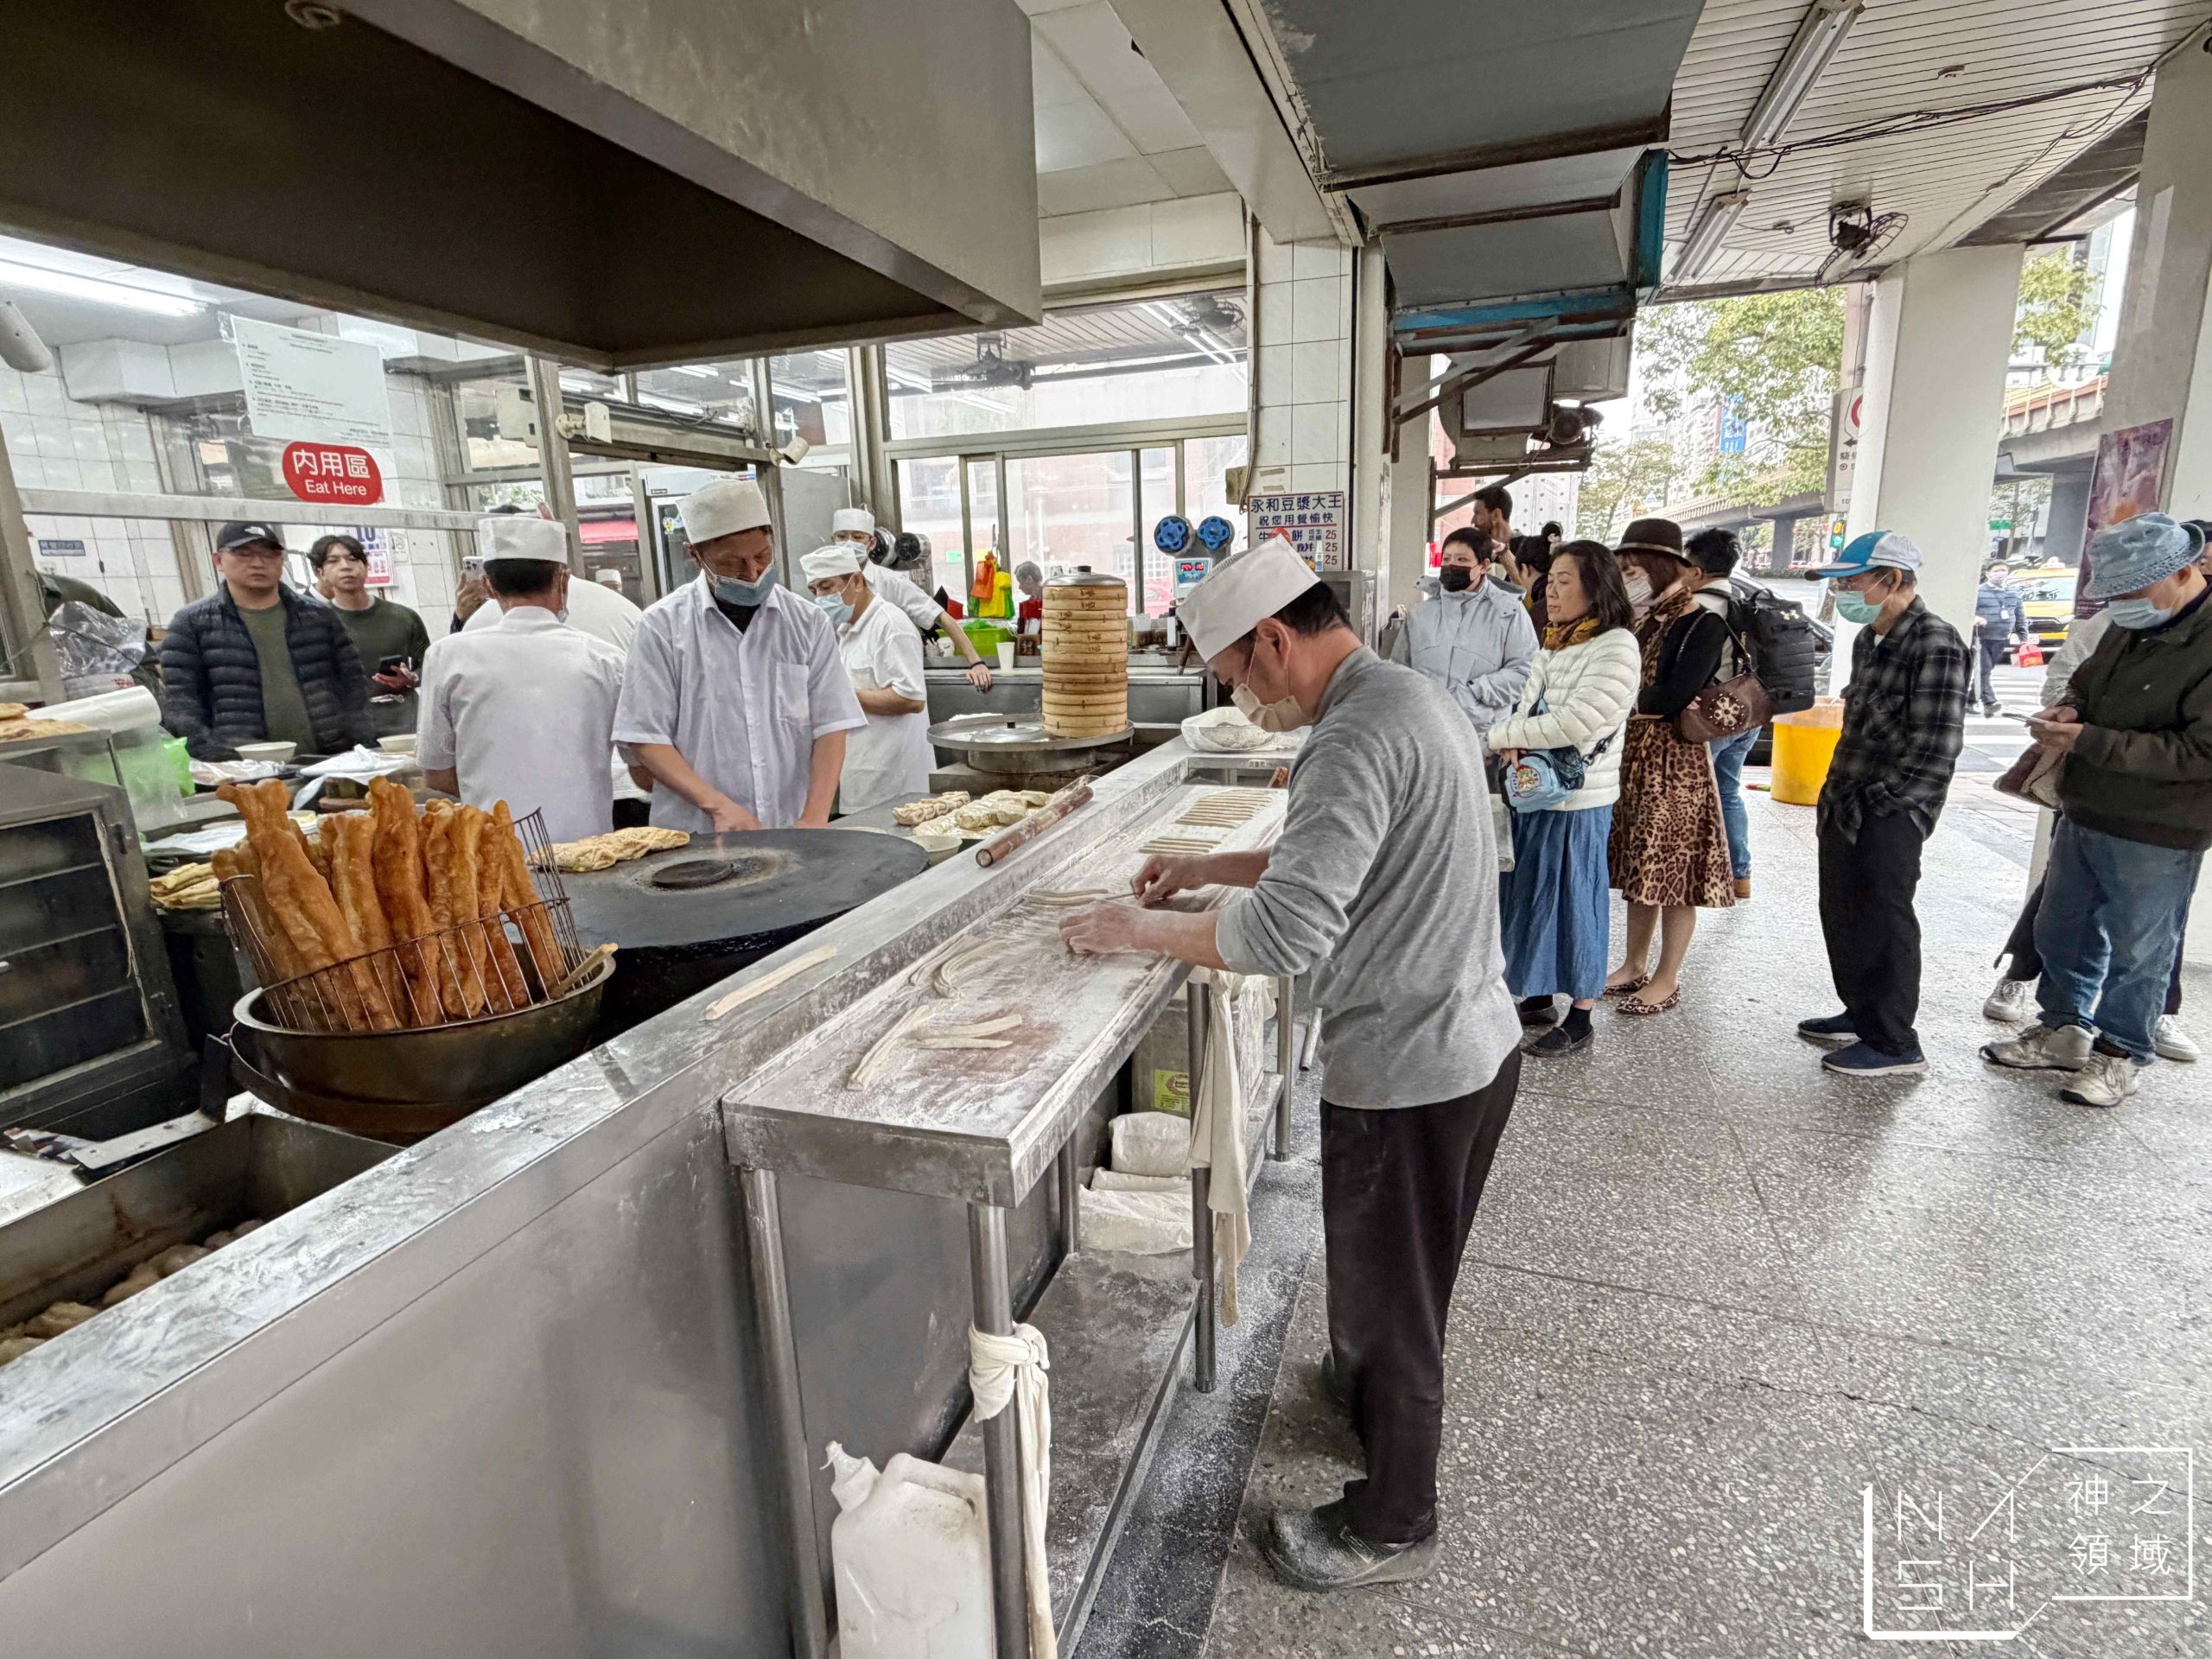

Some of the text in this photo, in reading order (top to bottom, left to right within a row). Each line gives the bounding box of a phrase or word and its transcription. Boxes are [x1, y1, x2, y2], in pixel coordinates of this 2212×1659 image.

[292, 448, 371, 479] 內用區
[305, 480, 367, 496] Eat Here
[1250, 493, 1343, 513] 永和豆漿大王
[1258, 512, 1334, 526] 祝您用餐愉快
[1325, 529, 1338, 540] 25
[1325, 542, 1338, 552] 25
[1325, 554, 1338, 565] 25
